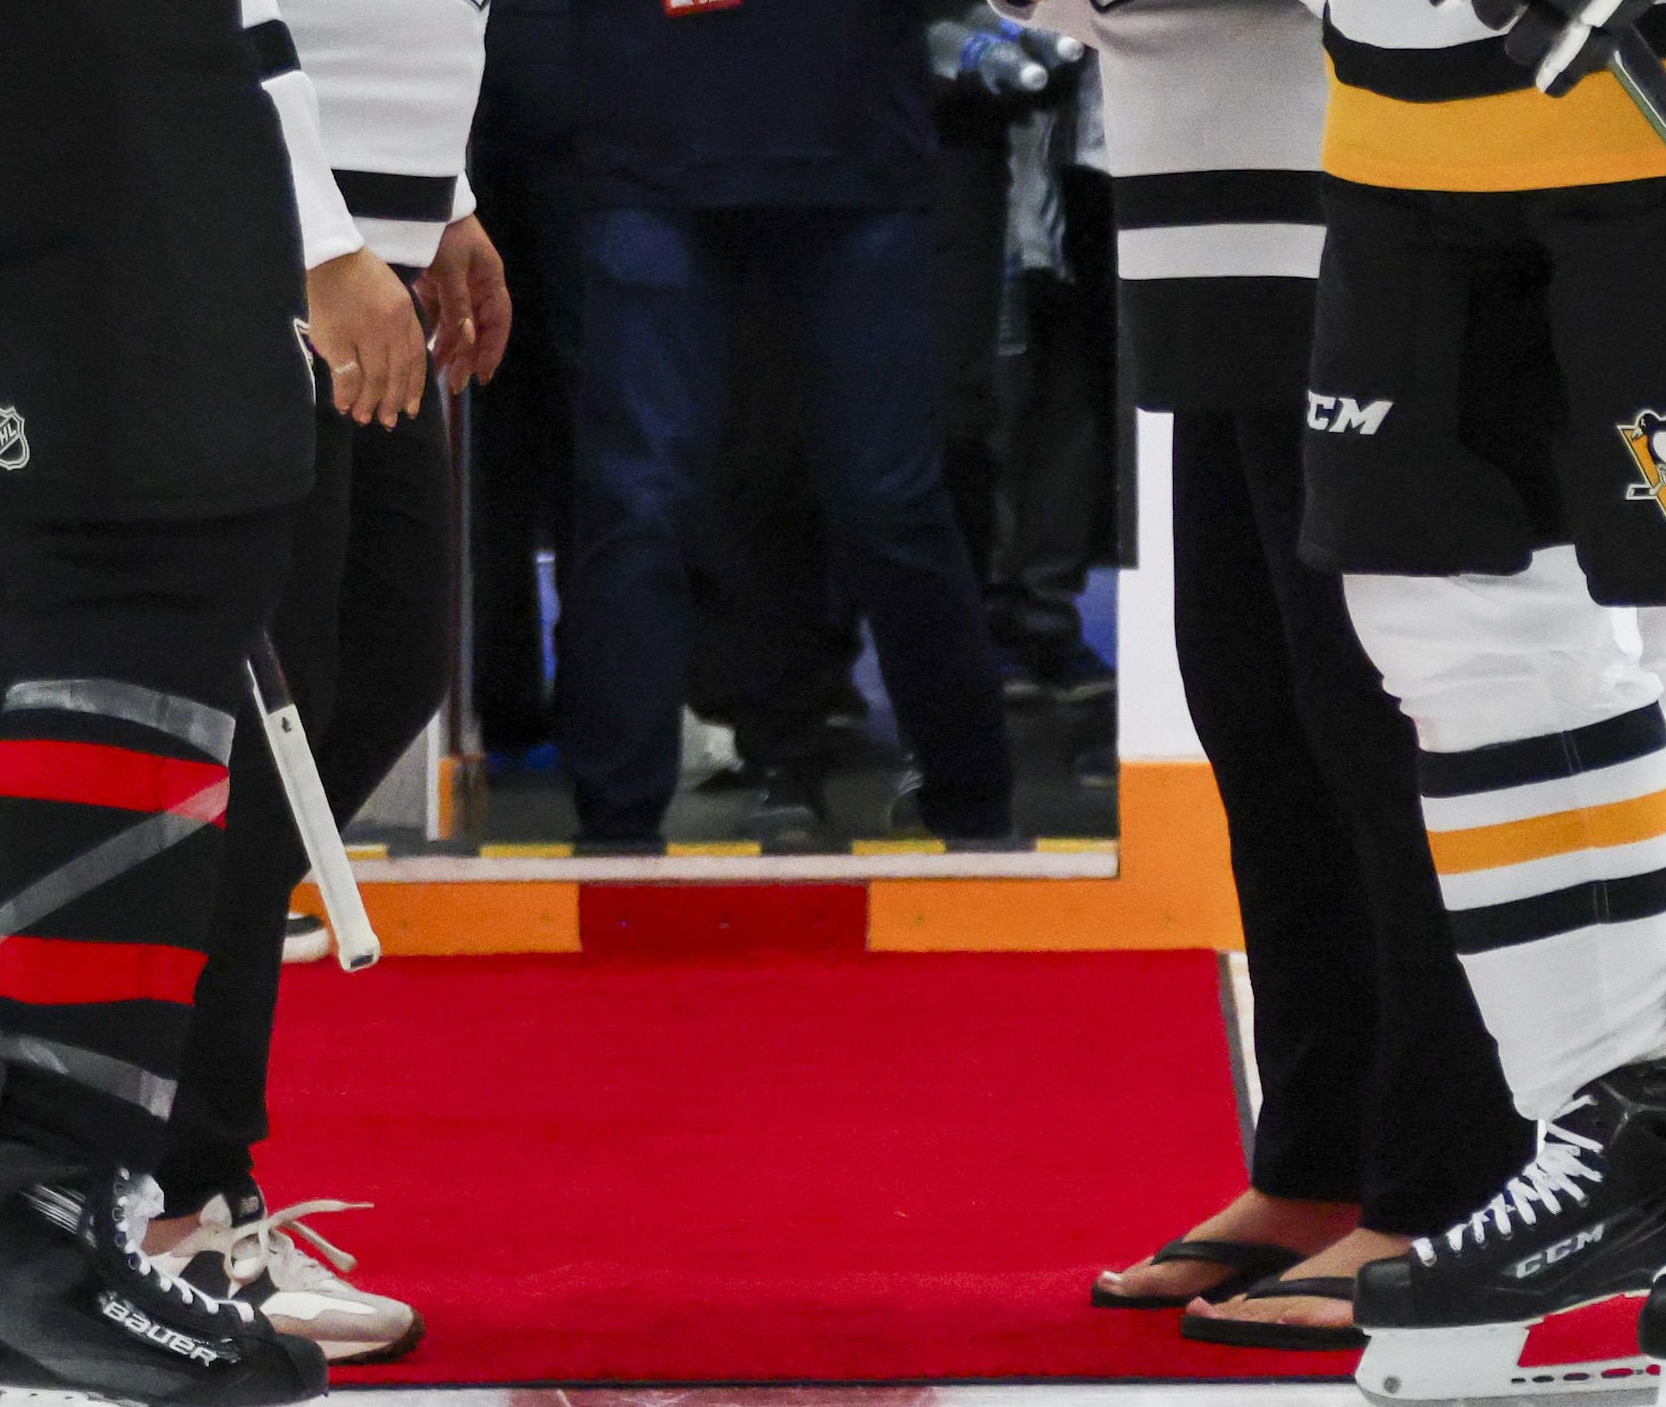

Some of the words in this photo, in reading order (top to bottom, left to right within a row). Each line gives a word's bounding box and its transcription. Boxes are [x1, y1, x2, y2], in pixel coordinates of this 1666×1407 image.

[1307, 389, 1393, 435] CM
[1516, 1223, 1605, 1279] CCM
[102, 1300, 217, 1367] BAUER
